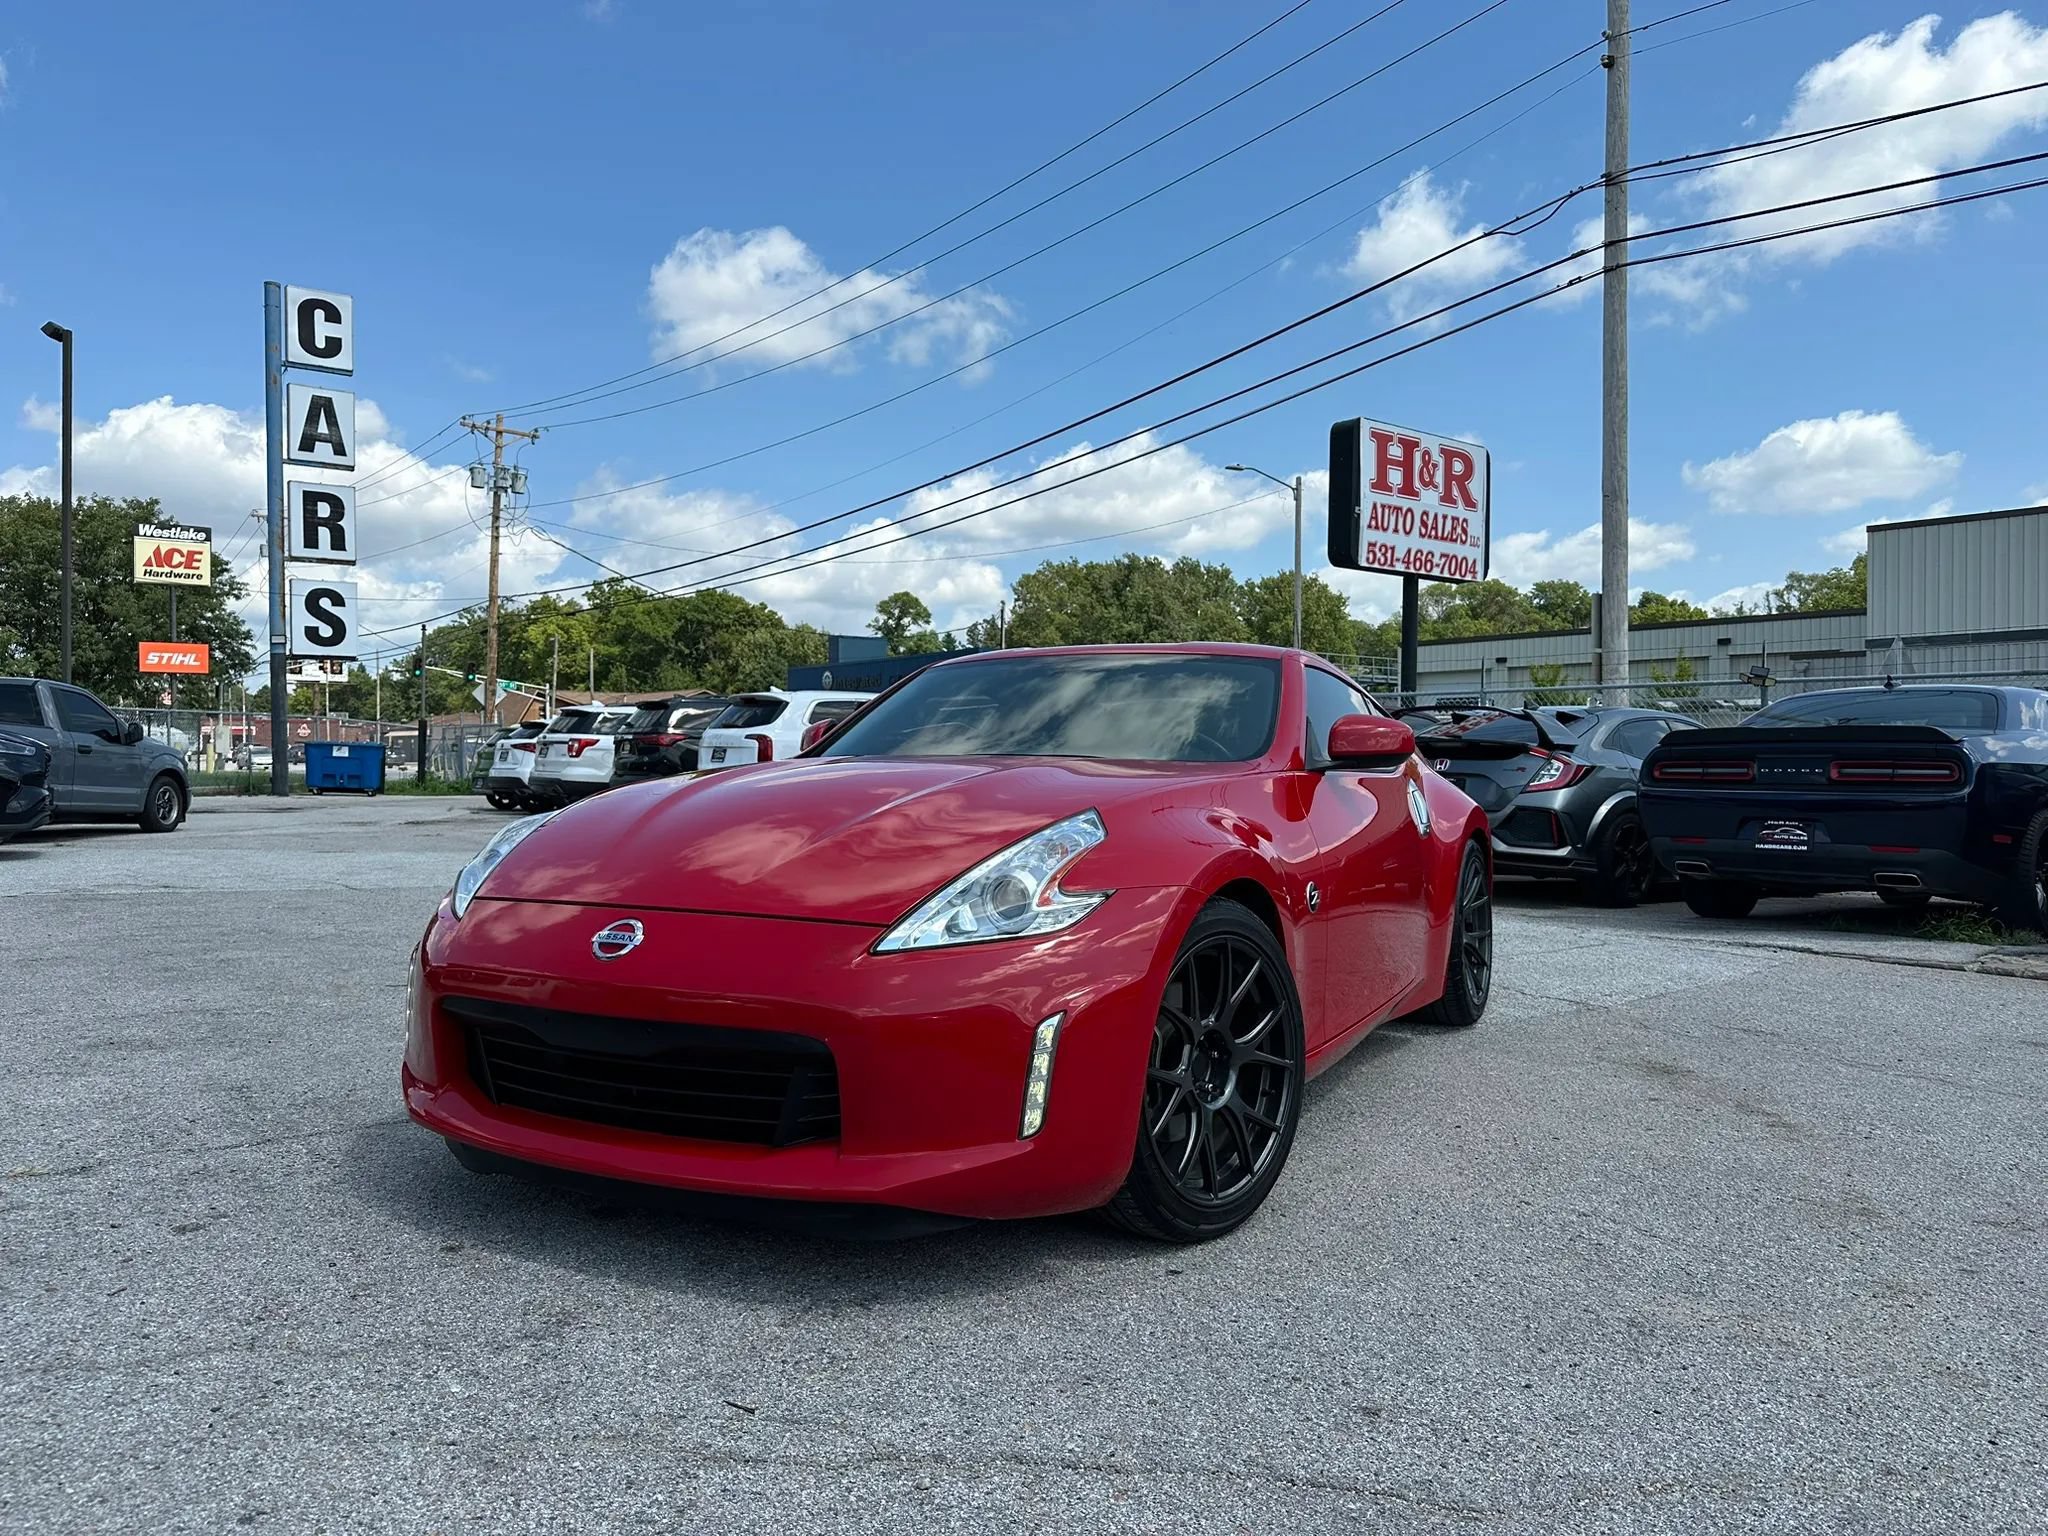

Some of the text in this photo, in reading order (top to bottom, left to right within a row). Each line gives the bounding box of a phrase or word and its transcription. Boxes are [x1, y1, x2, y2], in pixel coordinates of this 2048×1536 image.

[298, 298, 347, 647] CARS
[1369, 427, 1478, 511] H&R
[138, 524, 206, 541] Westlake
[1367, 502, 1480, 549] AUTO SALES LLC
[142, 544, 203, 570] ACE
[1366, 541, 1477, 579] 531-466-7004
[143, 569, 203, 581] Hardware
[146, 652, 201, 665] STIHL
[597, 933, 636, 943] NISSAN
